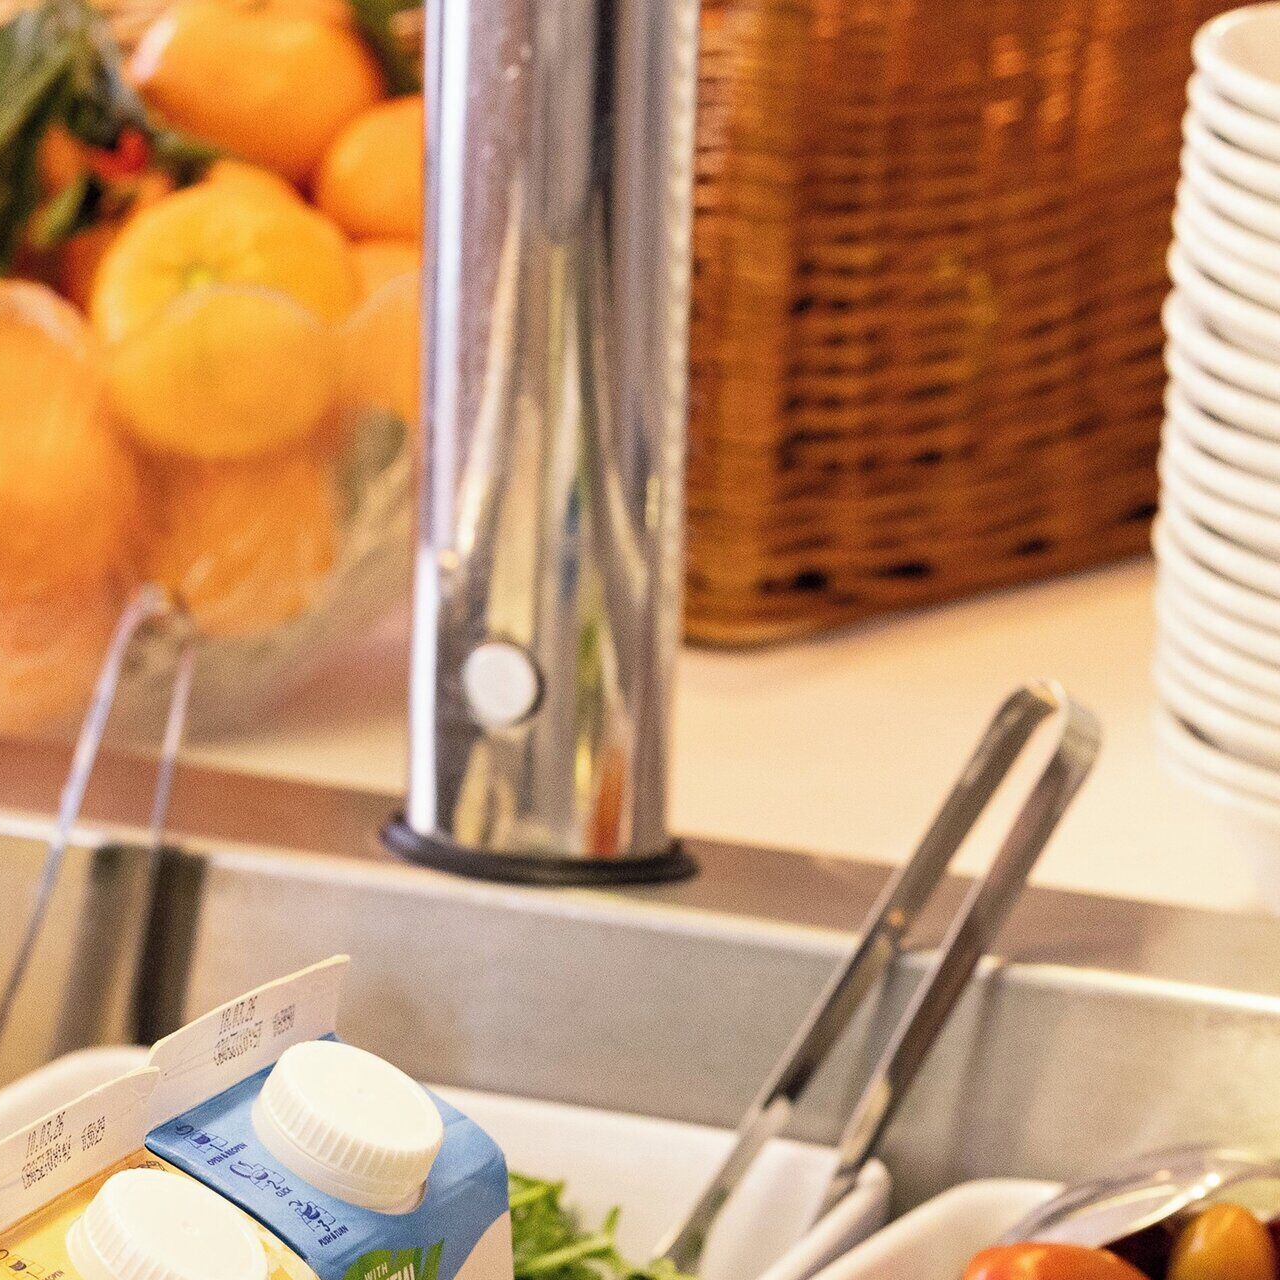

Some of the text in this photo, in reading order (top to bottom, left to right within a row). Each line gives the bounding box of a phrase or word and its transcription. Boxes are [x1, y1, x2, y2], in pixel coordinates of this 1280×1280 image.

[206, 1142, 248, 1166] OPEN & REOPEN
[268, 1179, 280, 1190] 2
[275, 1187, 293, 1198] CLICK
[317, 1219, 331, 1232] 3
[318, 1235, 333, 1247] PUSH
[335, 1225, 349, 1237] TURN
